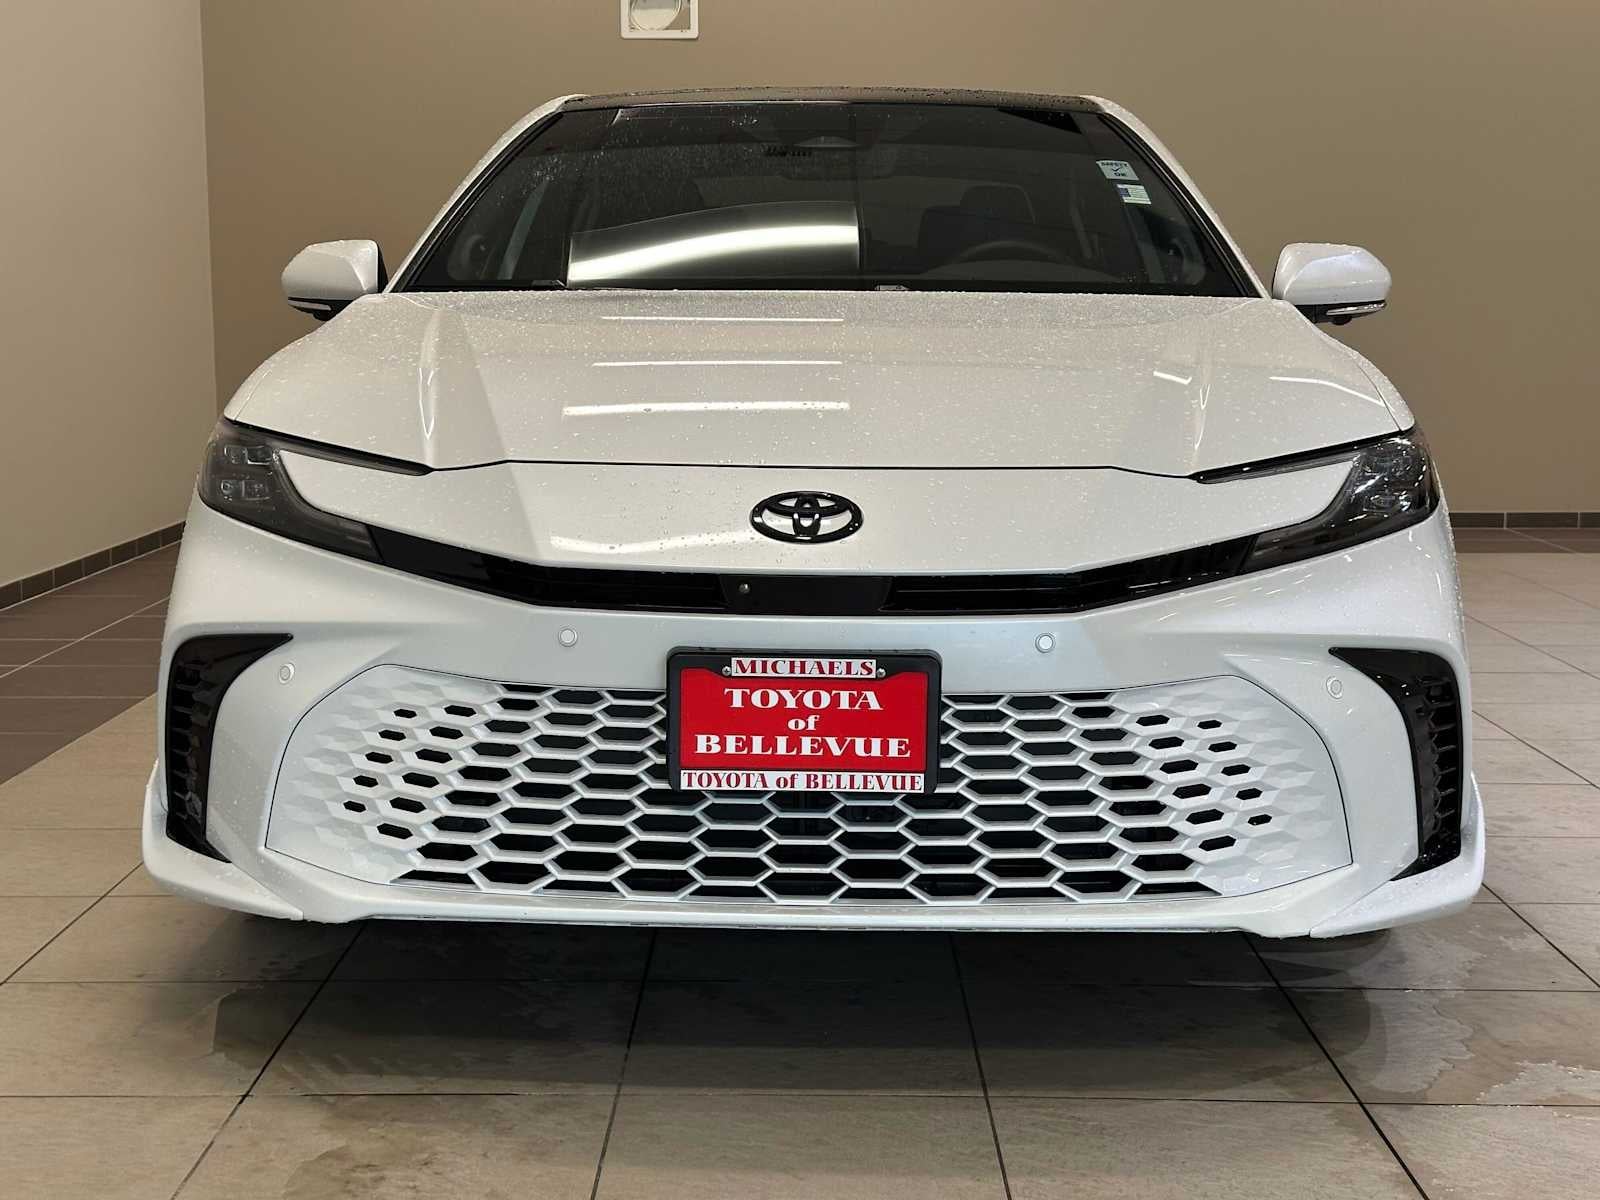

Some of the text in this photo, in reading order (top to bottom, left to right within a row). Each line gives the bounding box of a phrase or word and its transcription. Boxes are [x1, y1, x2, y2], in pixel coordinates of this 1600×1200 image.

[735, 659, 874, 676] MICHAELS
[724, 688, 884, 711] TOYOTA
[787, 714, 820, 731] of
[694, 734, 911, 758] BELLEVUE
[682, 772, 922, 791] TOYOTA of BELLEVUE
